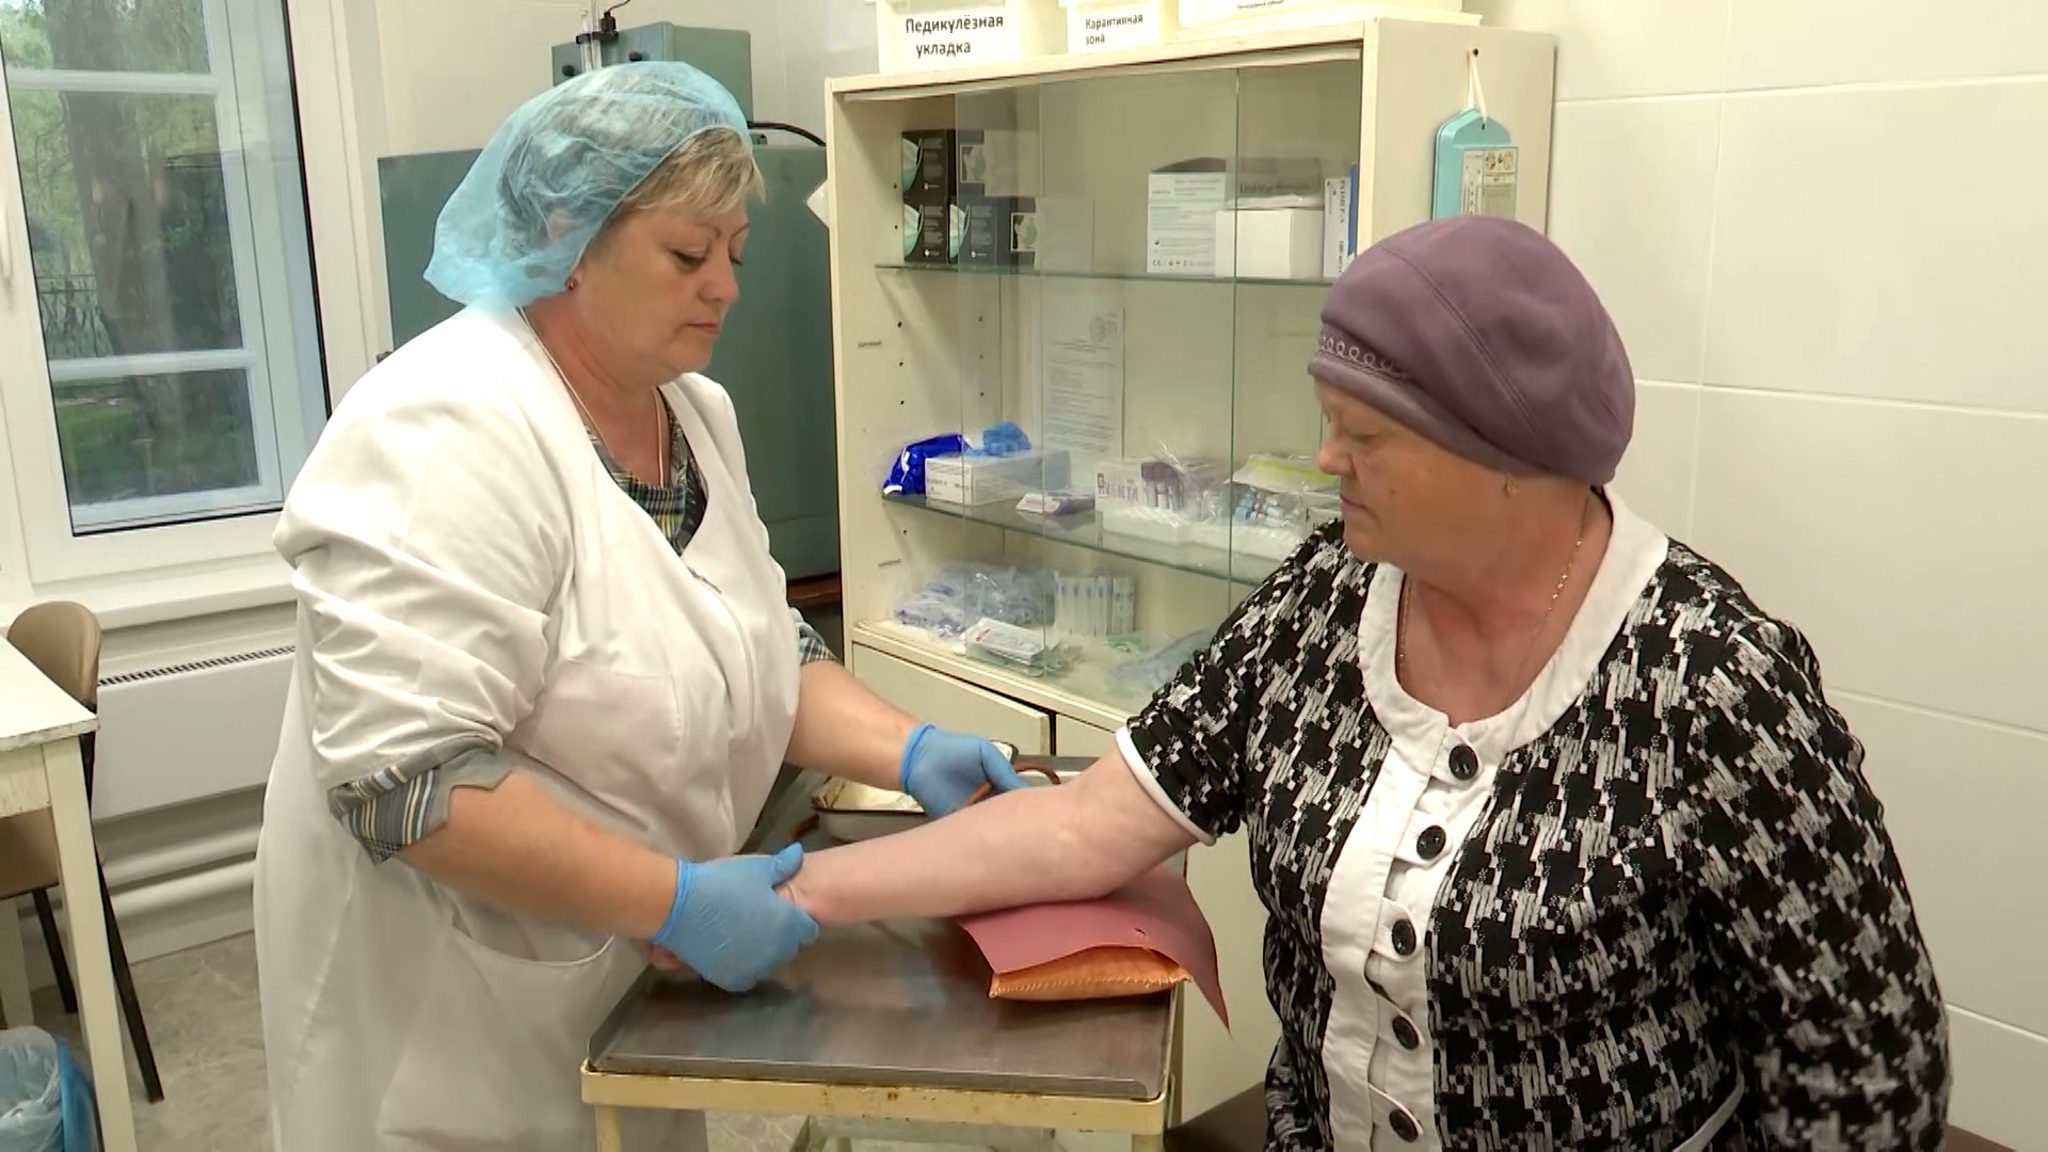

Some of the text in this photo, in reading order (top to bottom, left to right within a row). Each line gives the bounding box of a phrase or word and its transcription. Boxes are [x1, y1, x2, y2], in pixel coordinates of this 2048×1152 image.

[905, 14, 1004, 35] Педикулёзная
[1085, 14, 1143, 31] Карантинная
[1085, 34, 1105, 46] зона
[915, 42, 971, 59] укладка
